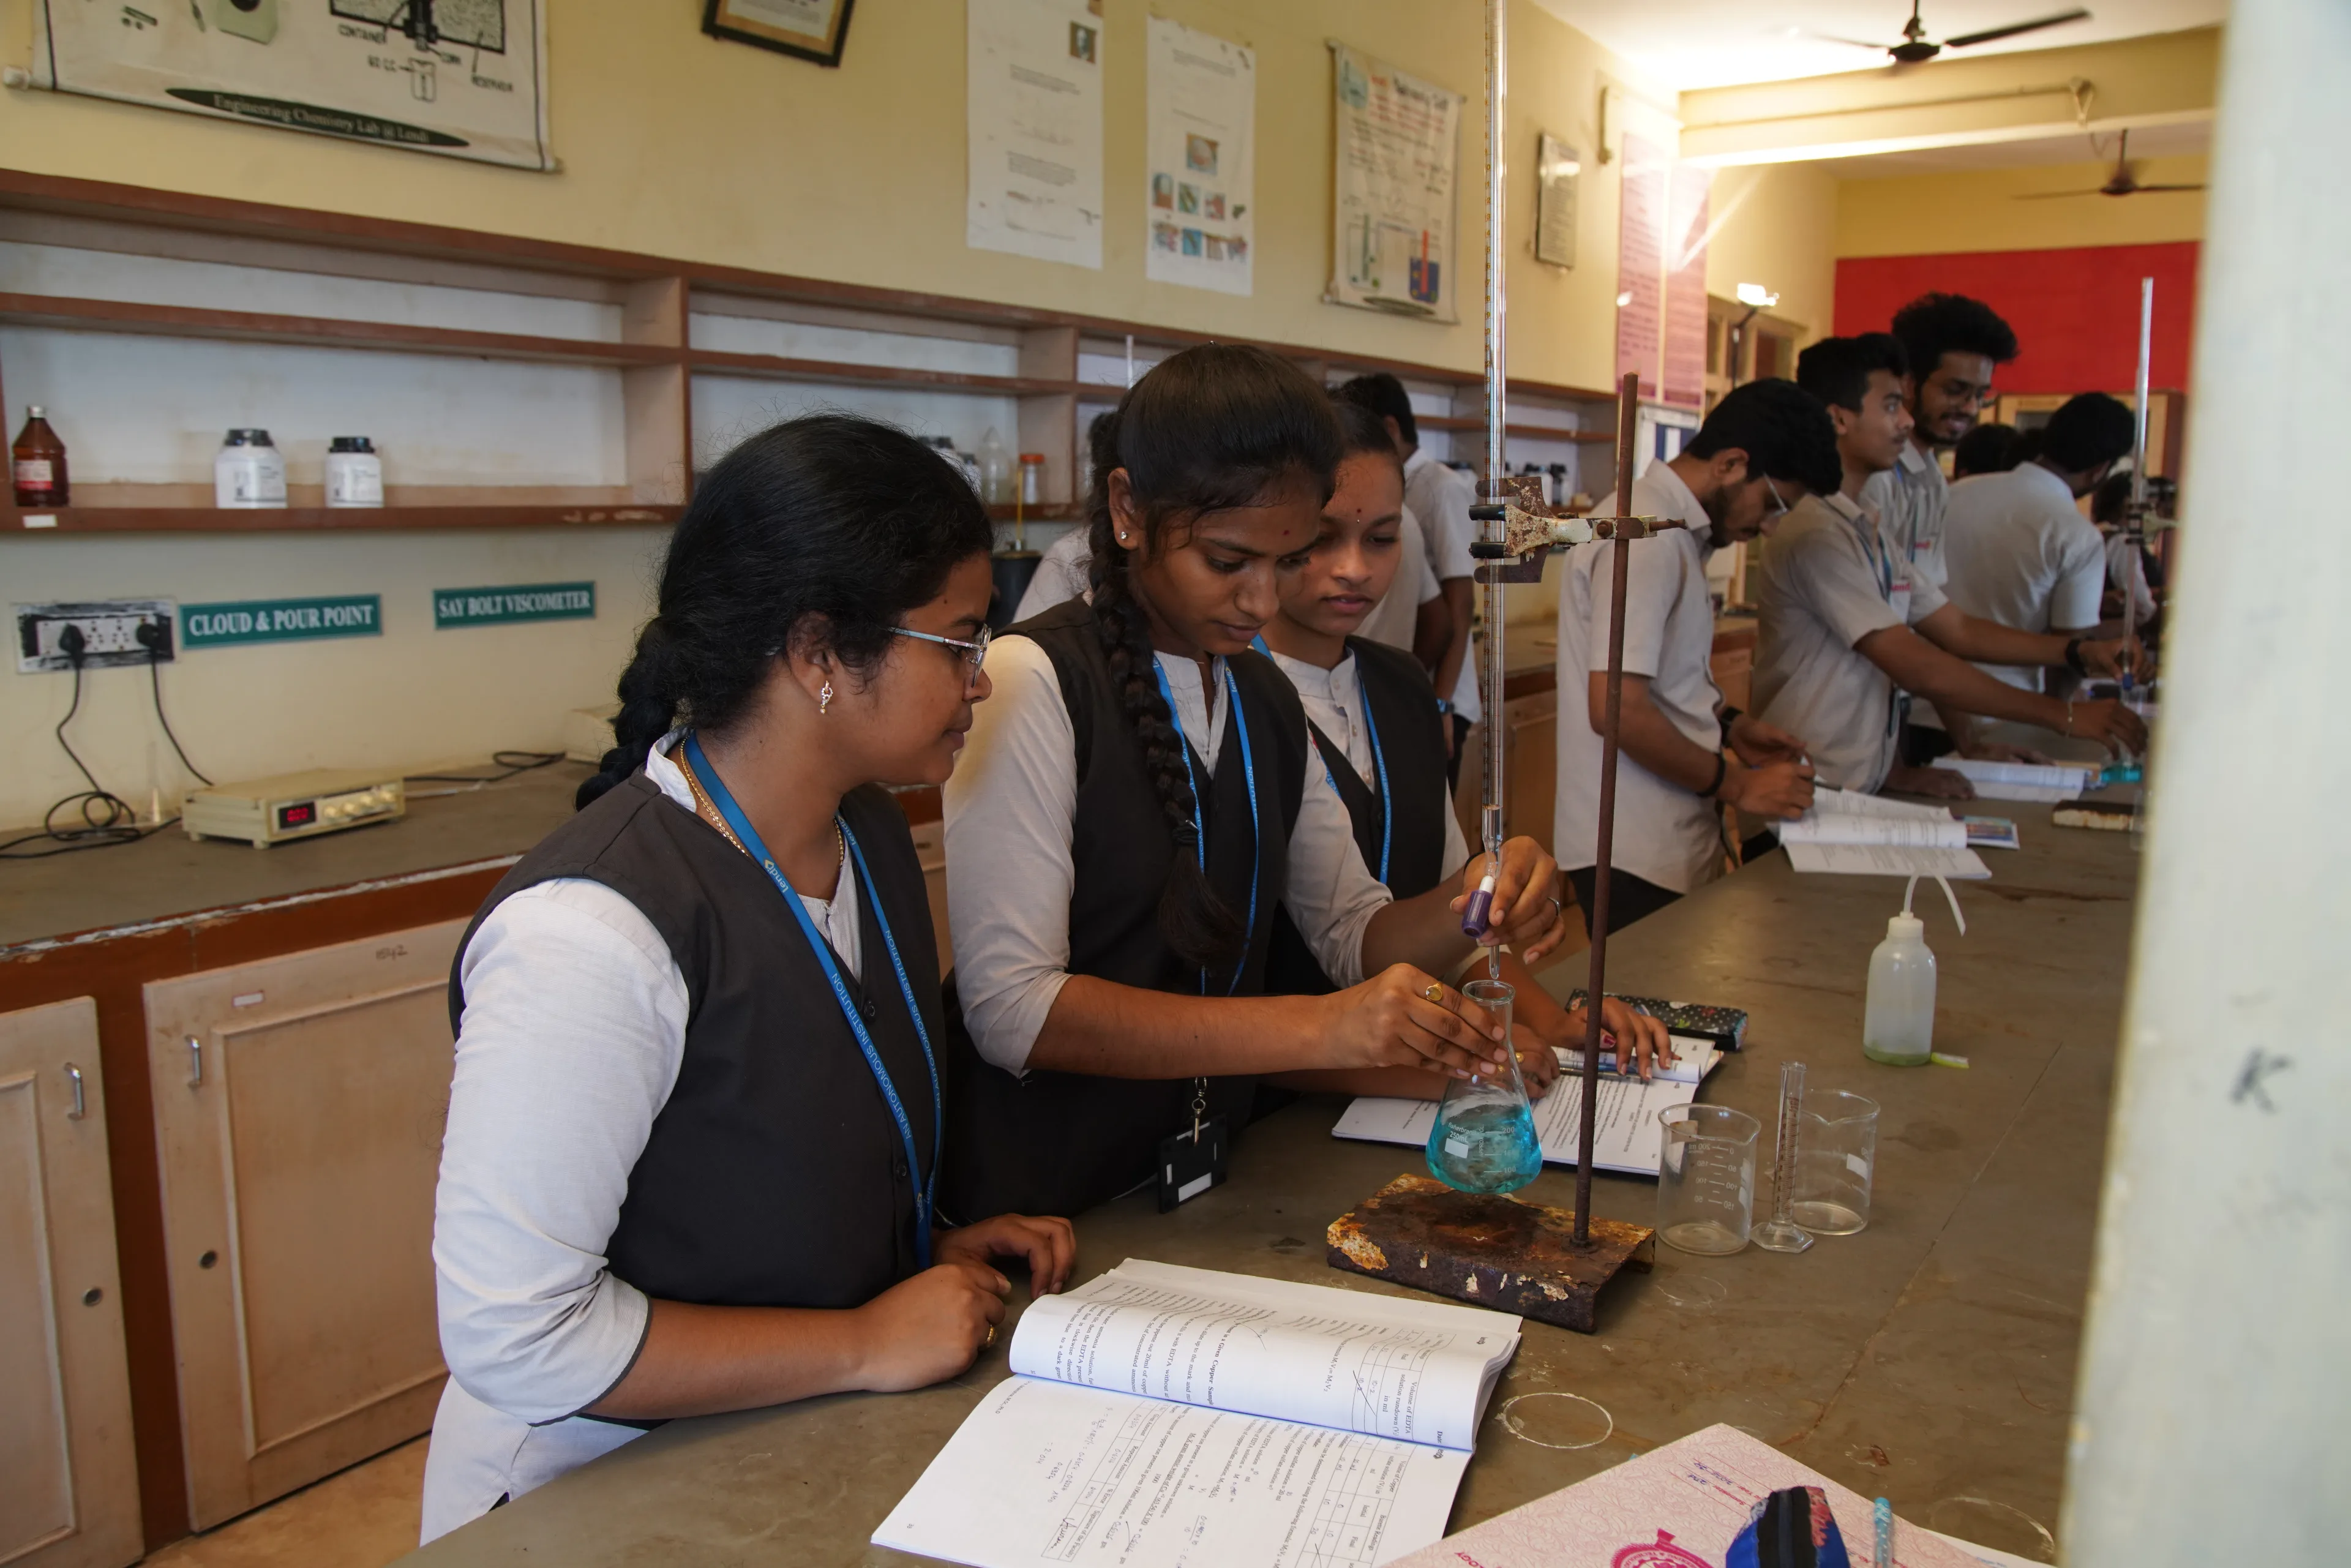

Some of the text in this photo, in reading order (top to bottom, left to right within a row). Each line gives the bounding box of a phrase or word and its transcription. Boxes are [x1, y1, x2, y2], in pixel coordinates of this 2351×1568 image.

[213, 94, 291, 121] Engineering
[293, 107, 354, 133] Chemistry
[357, 118, 381, 136] Lab
[438, 590, 591, 618] SAY BOLT VISCOMETER
[189, 604, 373, 636] CLOUD & POUR POINT
[1228, 671, 1237, 692] lendi
[1375, 745, 1391, 874] AN AUTONOMOUS INSTITUTION
[841, 819, 856, 846] lendi
[768, 865, 788, 893] lendi
[885, 930, 941, 1109] AN AUTONOMOUS INSTITUTION
[832, 973, 912, 1139] AN AUTONOMOUS INSTITUTION
[2230, 1048, 2295, 1114] K
[1450, 1131, 1469, 1143] 250mL
[1064, 1323, 1073, 1333] blue
[1086, 1324, 1095, 1334] then
[1092, 1326, 1104, 1348] ammonia
[1151, 1328, 1160, 1343] pipette
[1198, 1330, 1207, 1340] dilute
[1068, 1329, 1081, 1355] clockwise
[1133, 1334, 1146, 1367] concentrated
[1215, 1343, 1224, 1357] Given
[1078, 1345, 1087, 1364] EDTA
[1166, 1348, 1176, 1367] EDTA
[1209, 1360, 1218, 1384] Copper
[1397, 1374, 1406, 1396] solution
[1408, 1382, 1417, 1405] Volume
[1382, 1403, 1388, 1412] ml
[1253, 1438, 1270, 1465] EDTA solution
[1295, 1444, 1304, 1455] copper
[1115, 1446, 1139, 1481] Reported Amount
[1289, 1455, 1299, 1468] sulfate
[1311, 1458, 1324, 1480] determined
[1396, 1461, 1406, 1473] Volume
[1161, 1444, 1201, 1514] present given unknown solution
[1283, 1469, 1292, 1485] solution
[1389, 1478, 1399, 1493] Copper
[1100, 1493, 1111, 1506] Error
[1120, 1486, 1141, 1515] 100ml solution
[1302, 1486, 1311, 1498] using
[1712, 1484, 1745, 1506] Semester
[1737, 1484, 1753, 1496] Year
[1084, 1507, 1100, 1531] Signature
[1291, 1505, 1305, 1525] following
[1349, 1505, 1370, 1548] Initial Final
[1368, 1515, 1386, 1551] Burette Readings
[1065, 1542, 1081, 1560] Faculty
